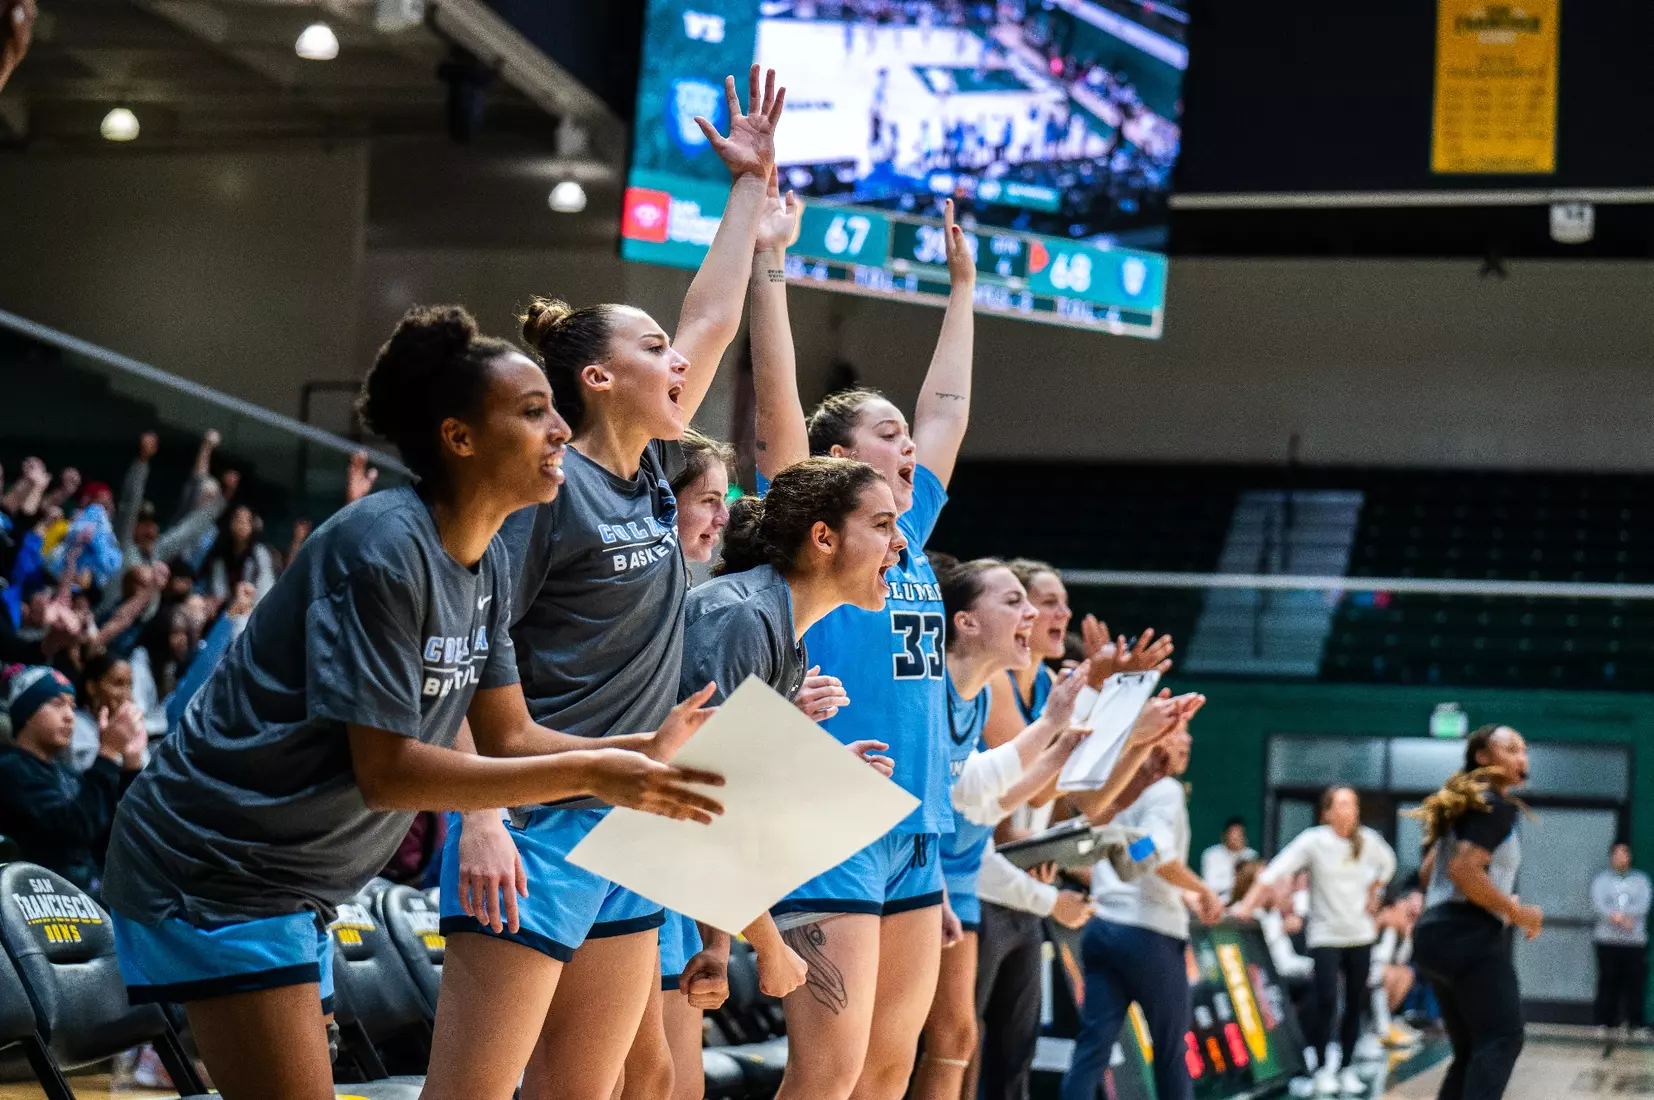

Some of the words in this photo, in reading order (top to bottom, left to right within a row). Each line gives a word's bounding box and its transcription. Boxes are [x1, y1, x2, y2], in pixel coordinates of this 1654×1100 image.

[824, 214, 872, 255] 67
[1049, 252, 1093, 293] 68
[889, 609, 946, 681] 33
[28, 878, 55, 893] SAN
[12, 892, 101, 921] FRANCISCO
[44, 923, 82, 943] DONS
